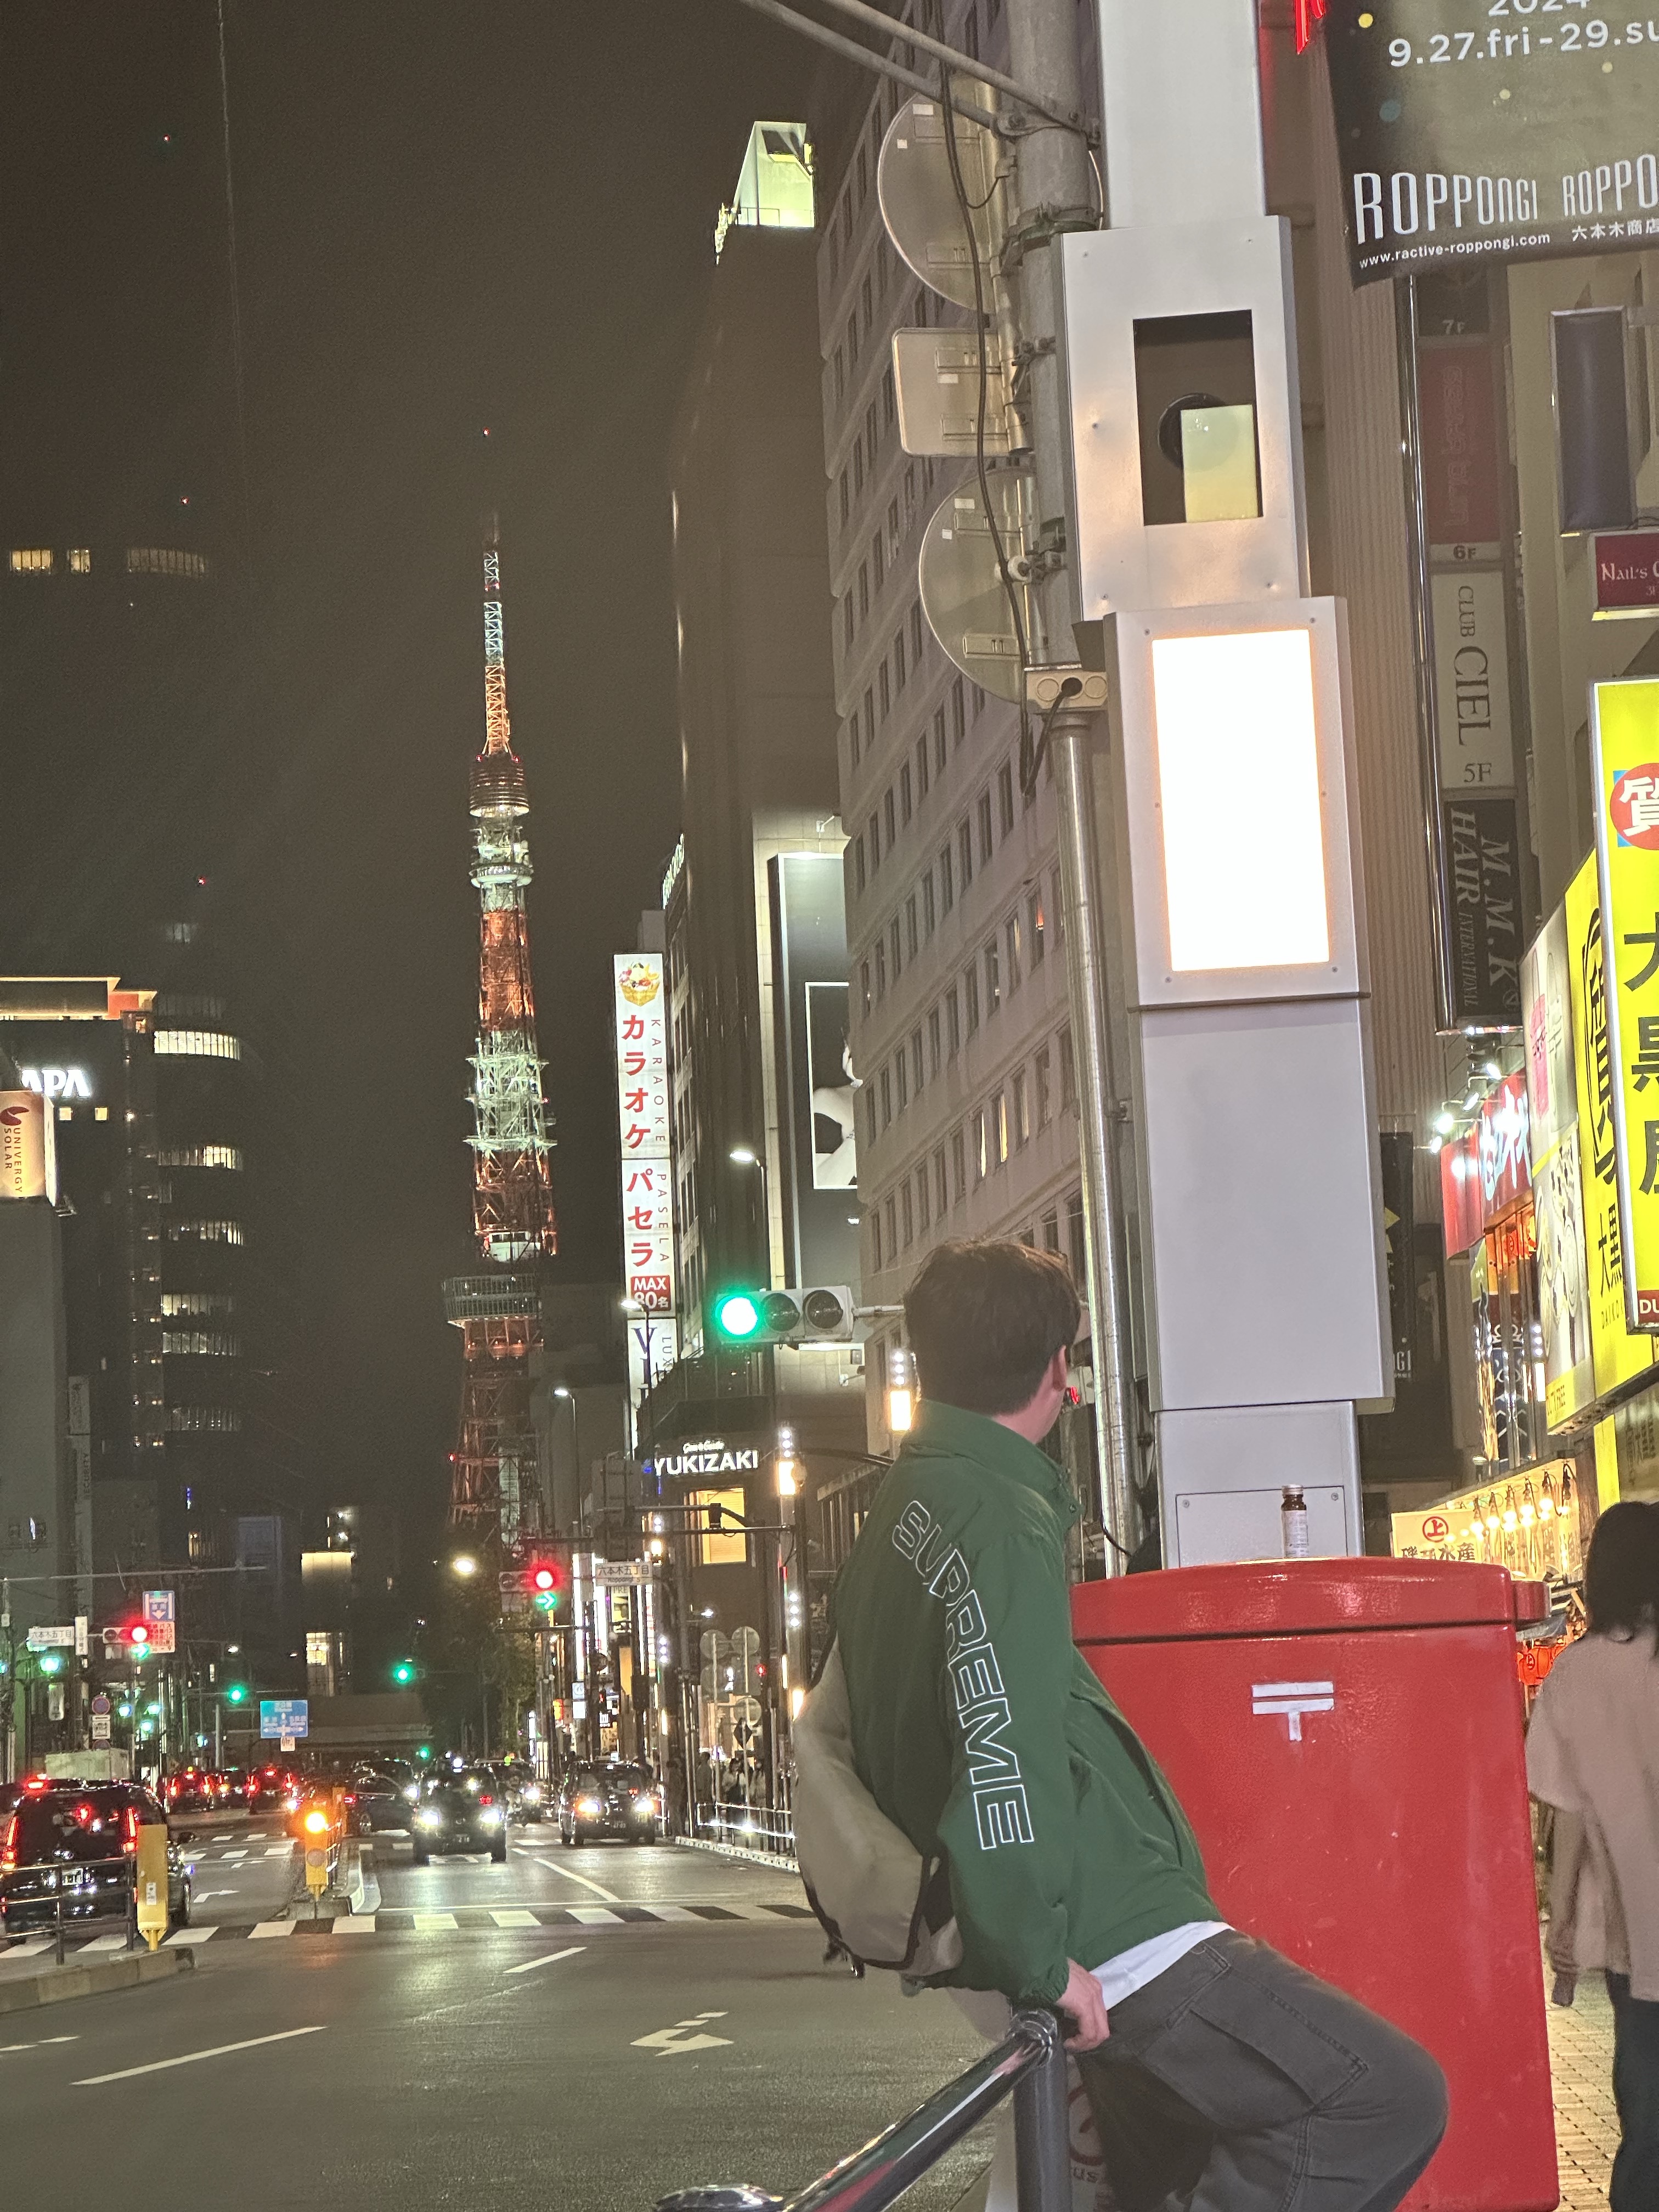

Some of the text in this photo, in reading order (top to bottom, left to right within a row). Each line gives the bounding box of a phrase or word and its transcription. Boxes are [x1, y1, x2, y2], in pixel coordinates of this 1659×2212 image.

[1353, 172, 1538, 245] ROPPONGI
[1359, 232, 1551, 269] www.ractive-roppongi.com
[1453, 545, 1476, 560] 6F
[1453, 585, 1491, 746] CLUB CIEL
[1464, 762, 1492, 783] 5F
[1451, 808, 1481, 905] HAIR
[21, 1069, 92, 1097] APA
[622, 1015, 651, 1149] カラオケ
[651, 1019, 665, 1141] KARAOKE
[3, 1127, 13, 1170] SOLAR
[12, 1127, 23, 1193] UNIVERGY
[626, 1168, 653, 1267] パセラ
[657, 1174, 670, 1261] PASELA
[634, 1277, 667, 1291] MAX
[654, 1450, 758, 1476] YUKIZAKI
[599, 1565, 650, 1576] 六本木五丁目
[892, 1500, 1034, 1850] SUPREME
